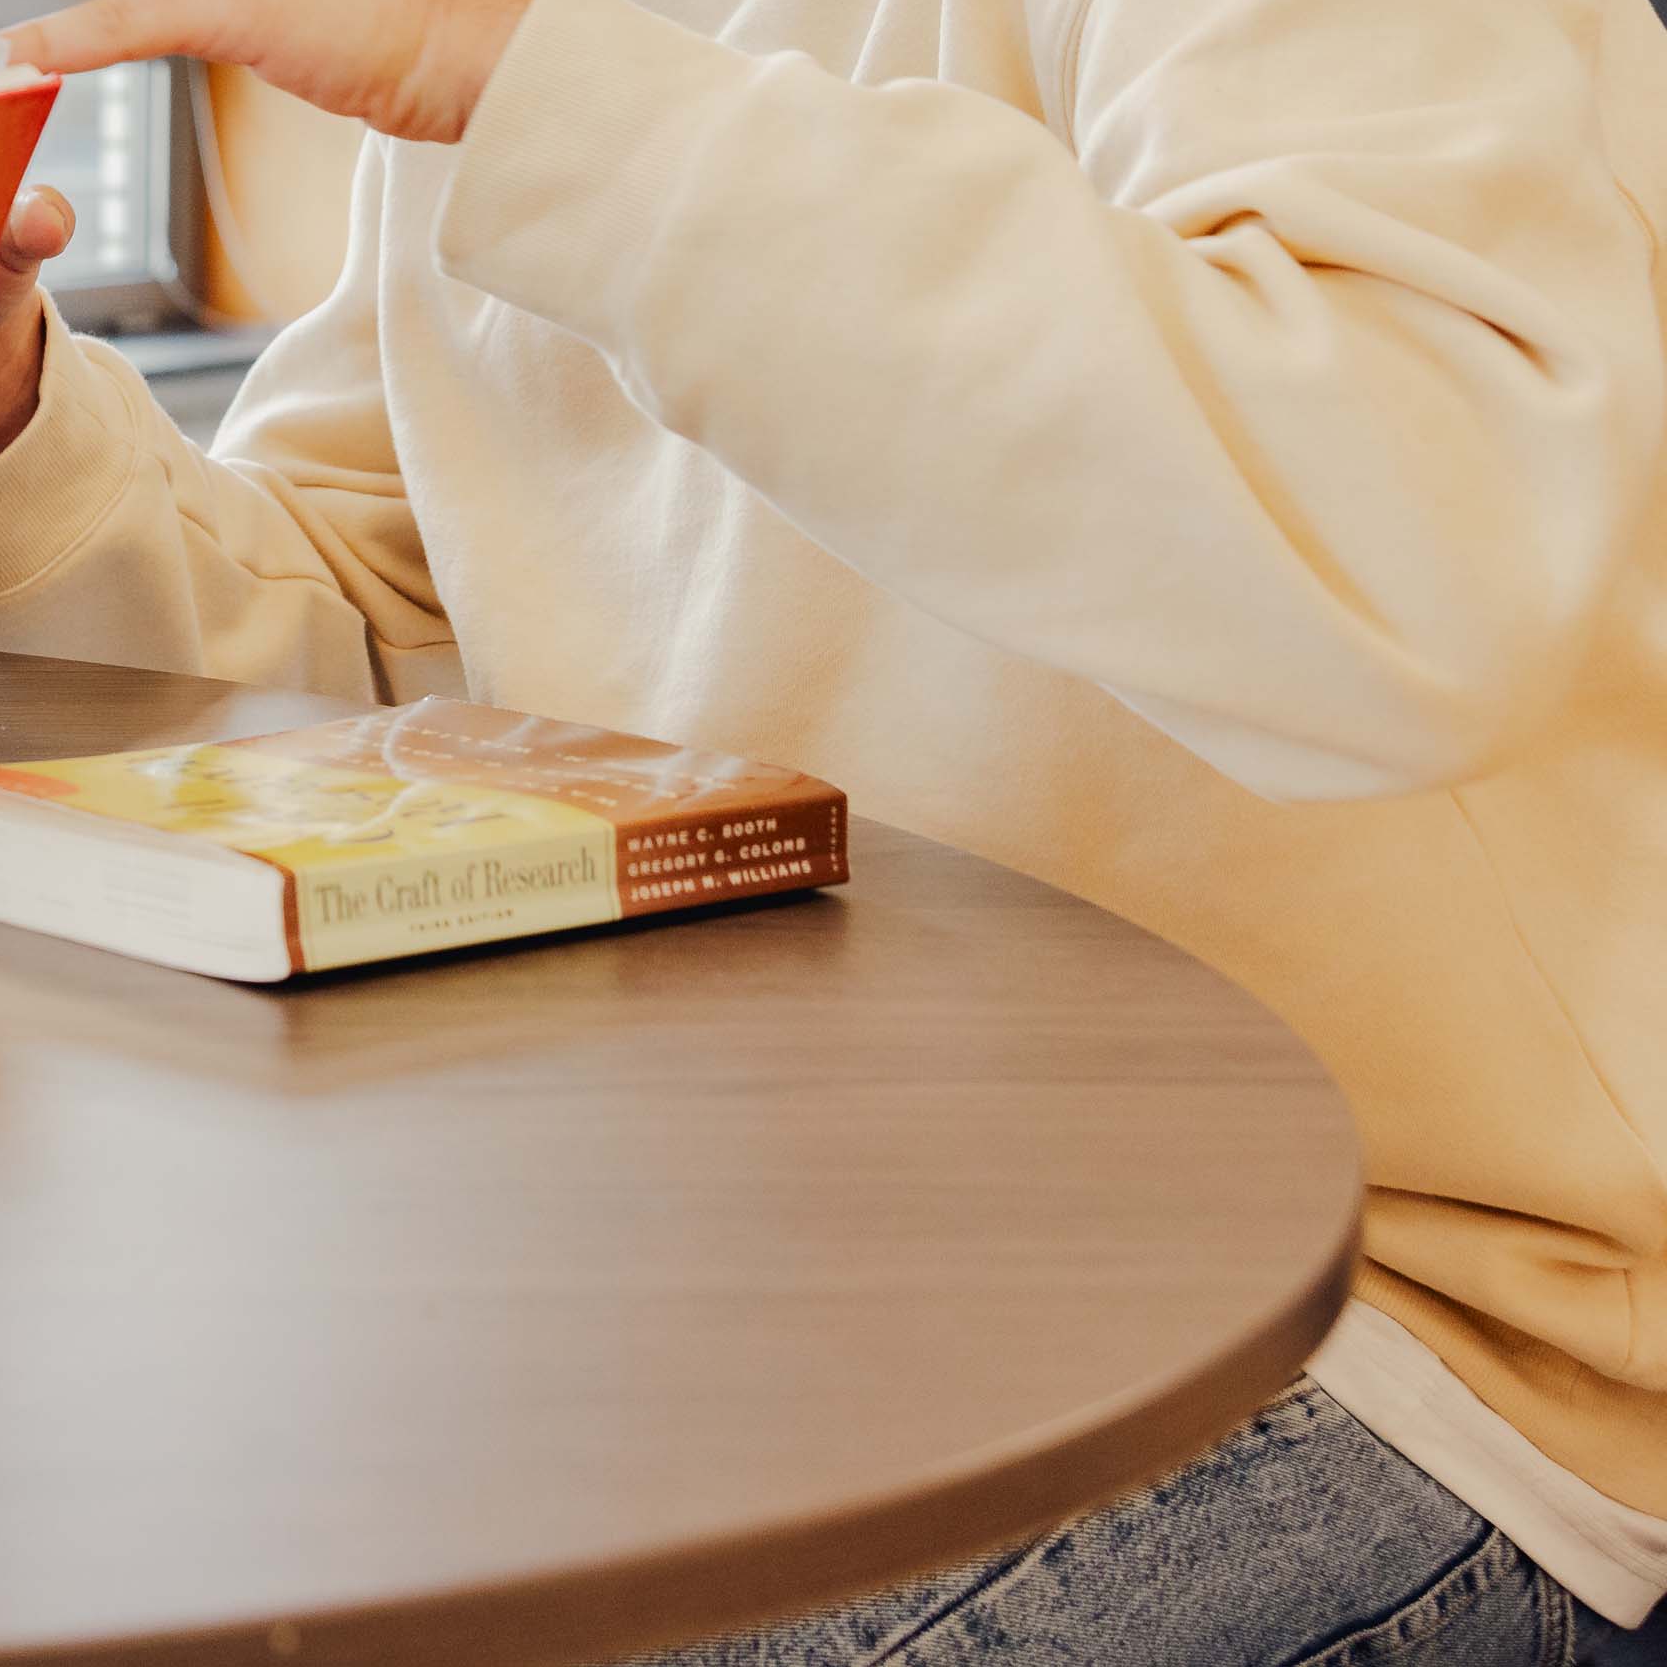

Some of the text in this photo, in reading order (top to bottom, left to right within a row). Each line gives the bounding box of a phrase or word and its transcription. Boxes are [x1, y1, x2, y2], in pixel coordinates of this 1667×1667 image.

[627, 818, 778, 852] WAYNE C. BOOTH
[627, 852, 706, 878] GREGORY
[739, 837, 806, 860] COLOMB
[313, 845, 596, 924] The Craft of Research
[629, 878, 696, 903] JOSEPH
[727, 859, 812, 886] WILLIAMS
